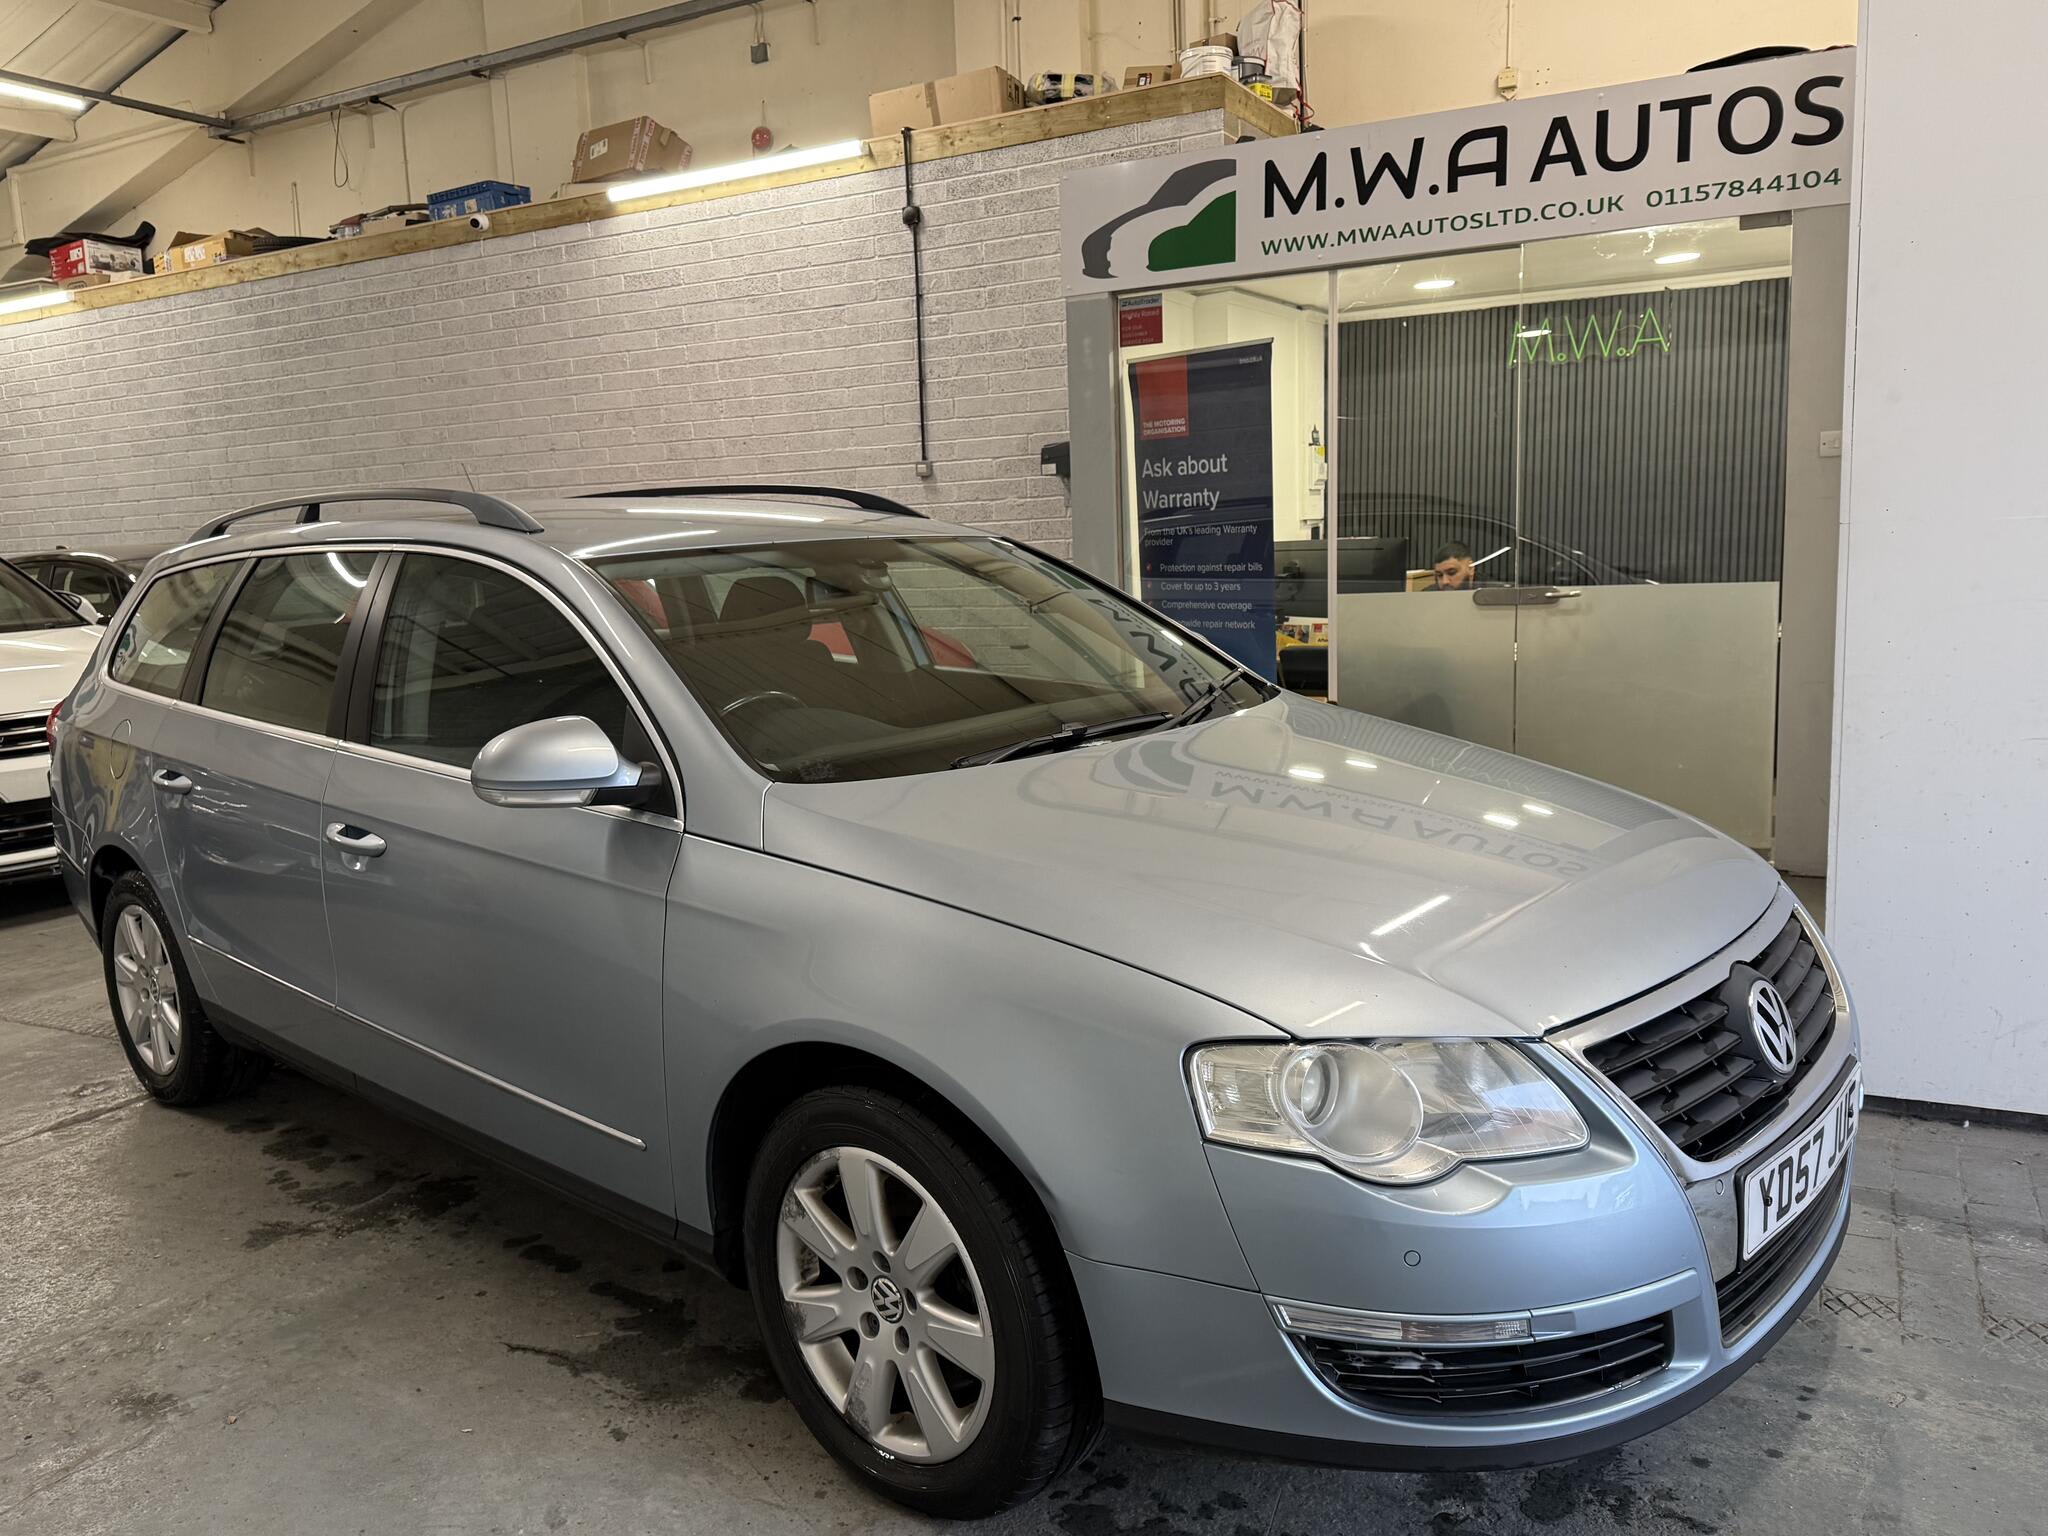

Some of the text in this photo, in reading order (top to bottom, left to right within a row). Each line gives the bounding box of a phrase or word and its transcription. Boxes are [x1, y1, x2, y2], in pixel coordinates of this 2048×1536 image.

[1264, 75, 1844, 218] M.W.A AUTOS
[1261, 168, 1842, 255] WWW.MWAAUTOSLTD.CO.UK 01157844104
[1509, 307, 1668, 366] M.W.A
[1143, 418, 1185, 429] THE MOTORING
[1144, 426, 1186, 436] ORGANISATION
[1142, 453, 1228, 479] Ask about
[1142, 488, 1220, 511] Warranty
[1144, 524, 1258, 536] From the UK's leading Warranty
[1144, 537, 1174, 547] provider
[1160, 561, 1263, 574] Protection against repair bills
[1161, 581, 1241, 593] Cover for up to 3 years
[1161, 600, 1253, 612] Comprehensive coverage
[1202, 620, 1224, 630] repair
[1225, 620, 1256, 630] network
[1760, 1125, 1825, 1234] YD57
